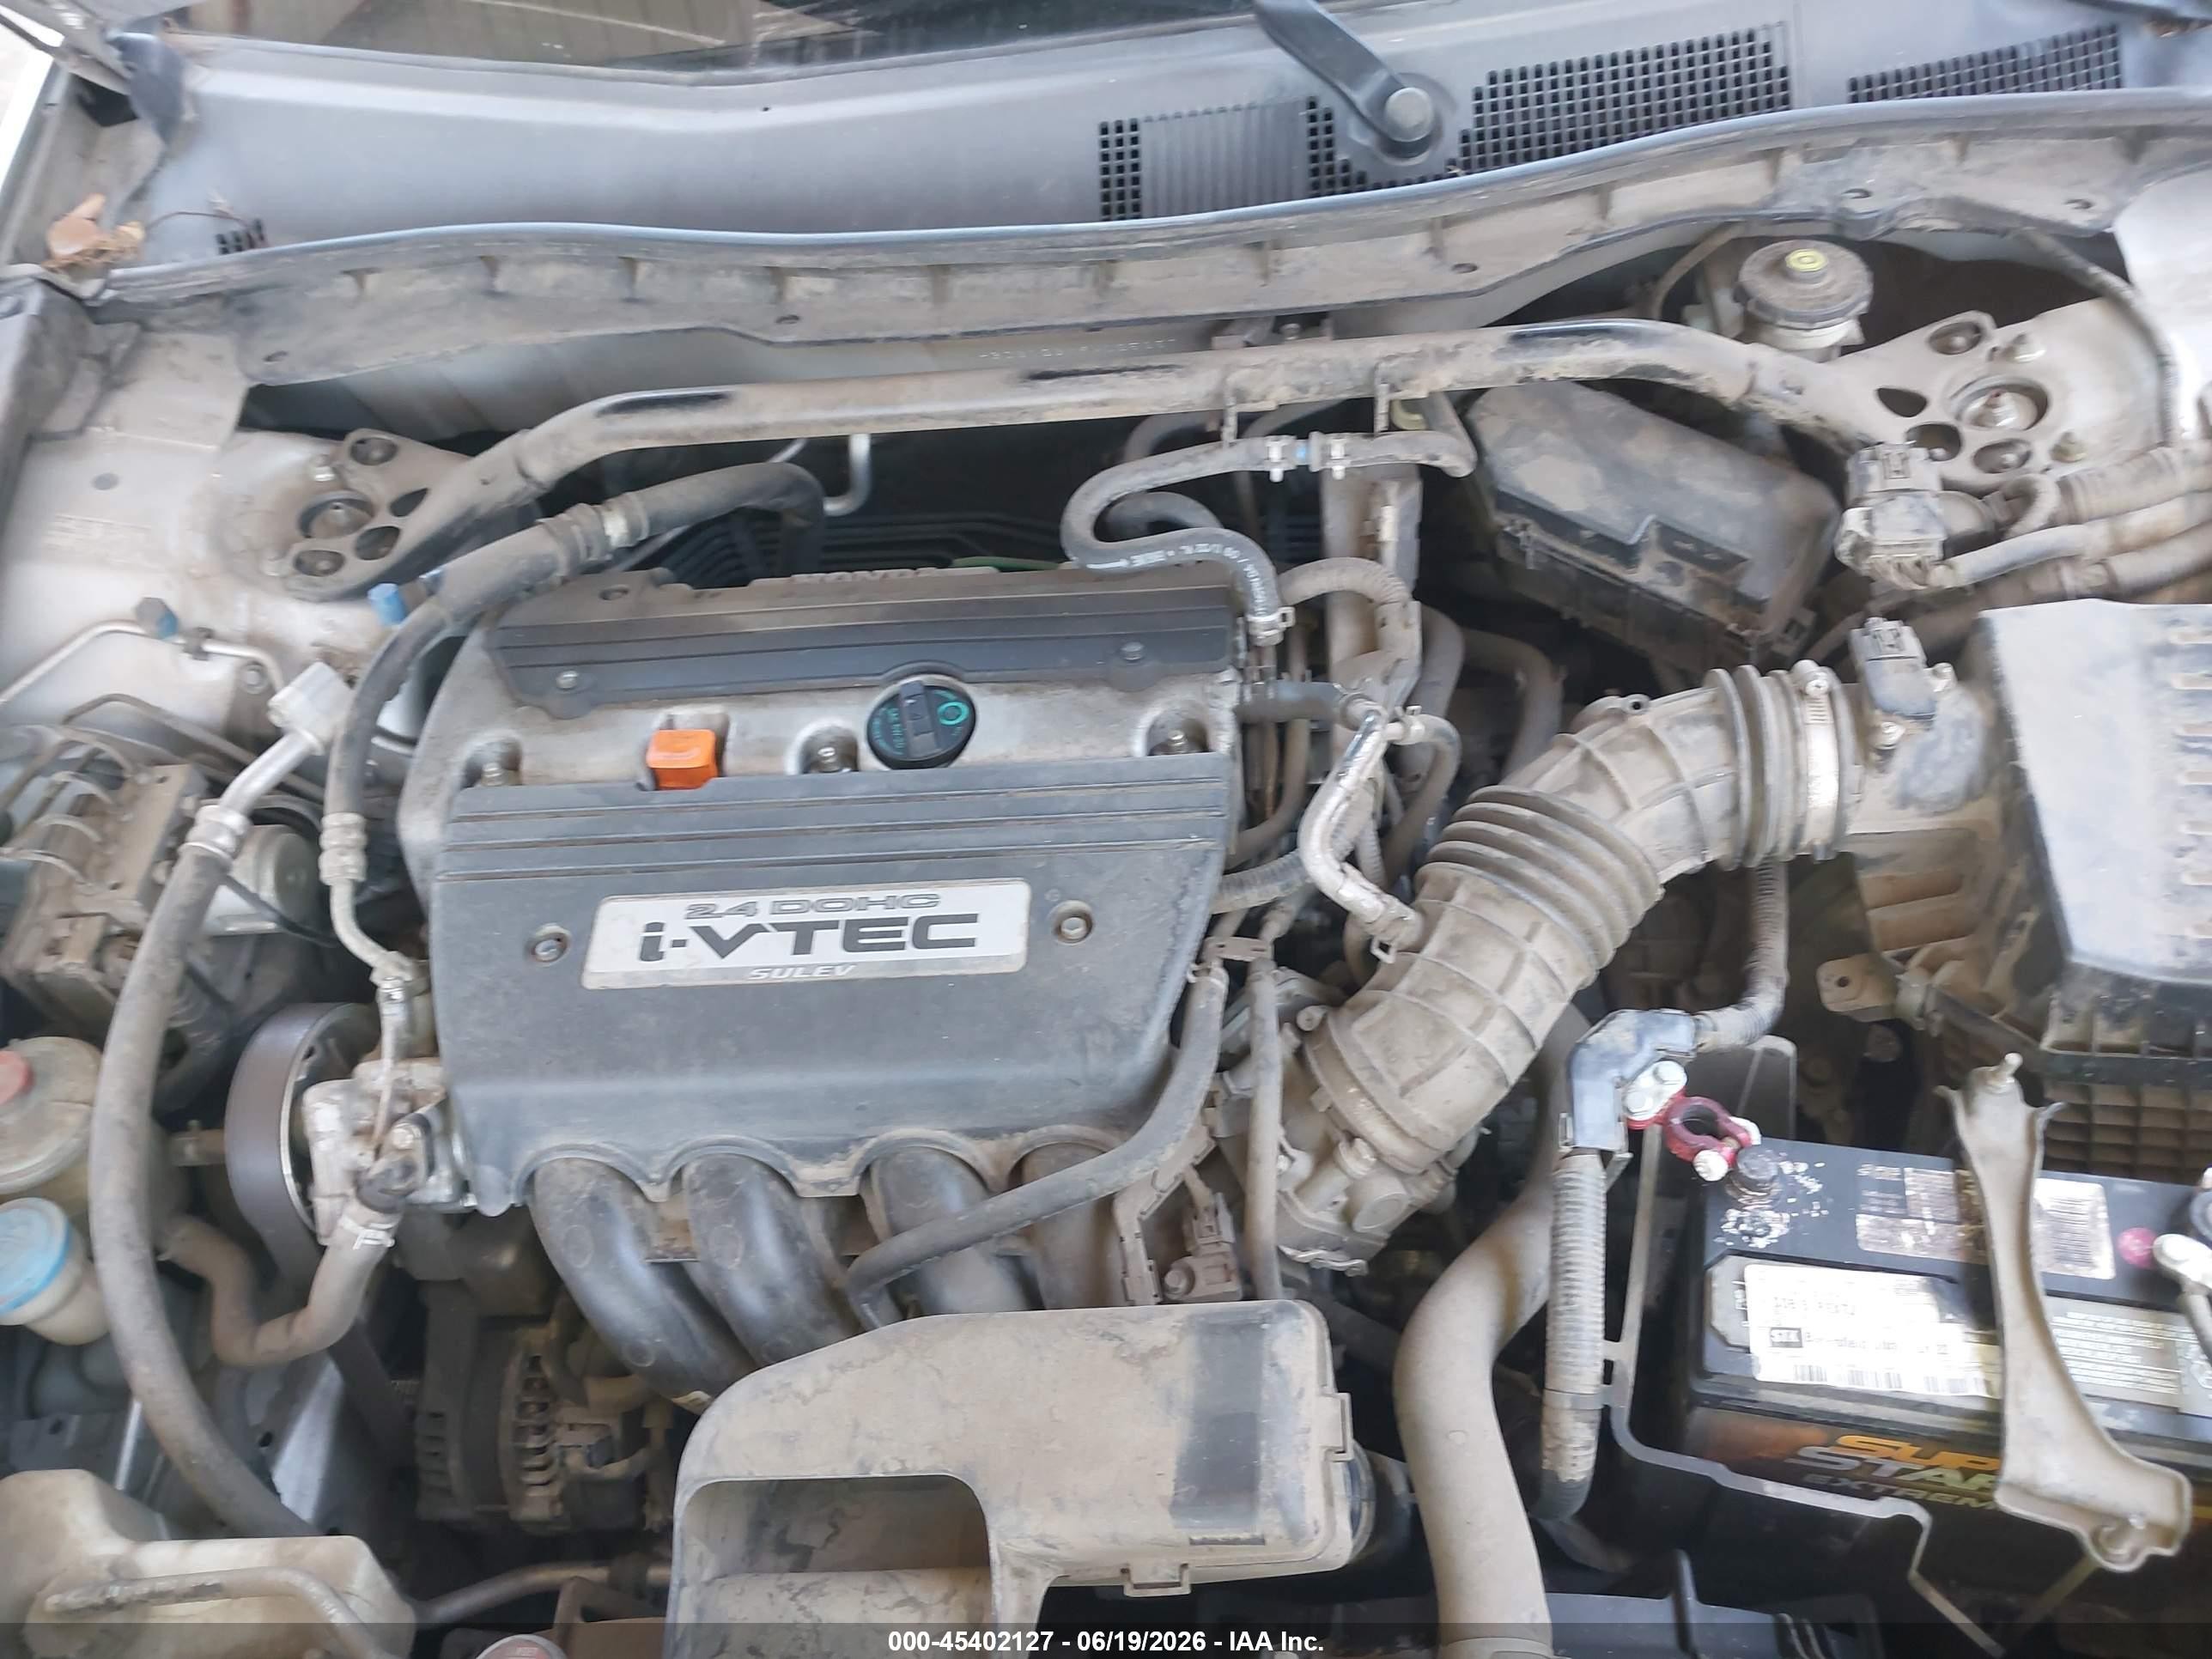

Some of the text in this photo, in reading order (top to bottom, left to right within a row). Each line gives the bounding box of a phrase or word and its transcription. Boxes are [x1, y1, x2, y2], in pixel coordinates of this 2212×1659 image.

[684, 893, 940, 920] 2.4 DOHC
[638, 913, 980, 963] i-VTEC
[748, 963, 858, 981] SULEV
[1834, 1435, 2002, 1471] SUP
